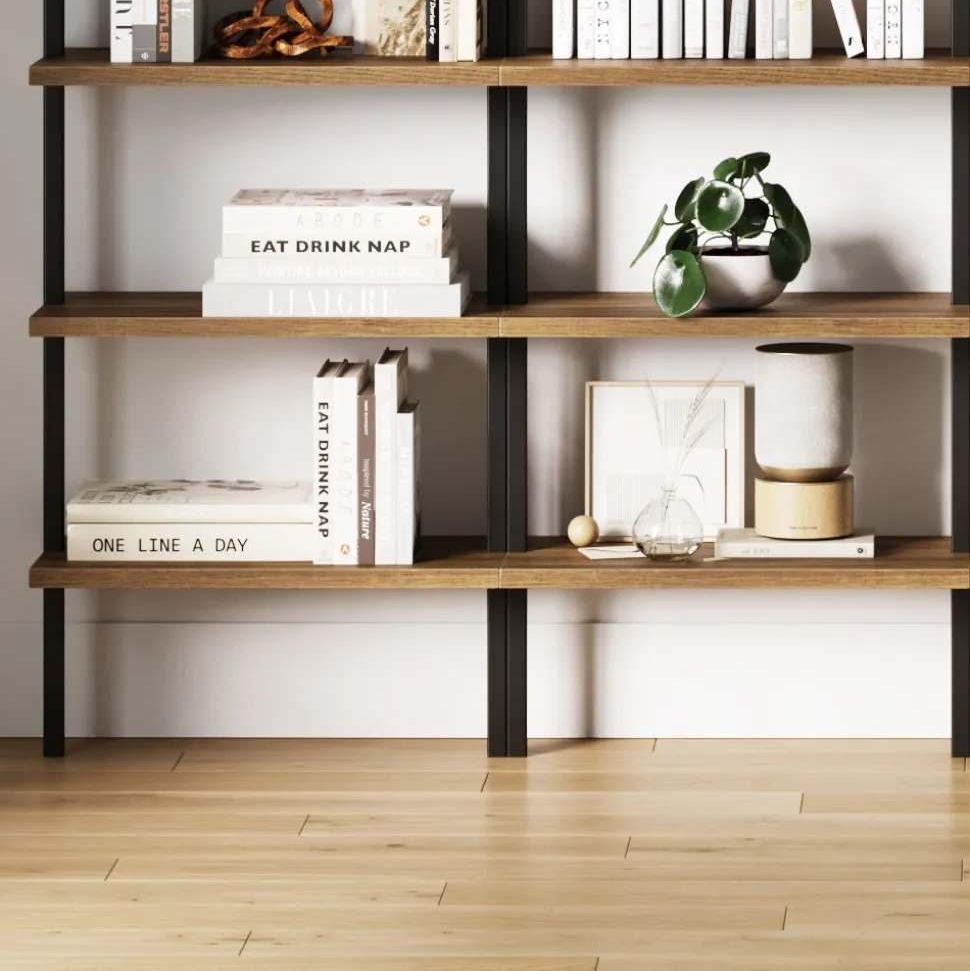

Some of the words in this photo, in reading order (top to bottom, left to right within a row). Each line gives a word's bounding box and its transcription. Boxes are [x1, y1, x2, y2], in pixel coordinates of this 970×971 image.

[428, 26, 436, 45] Gray
[251, 240, 289, 253] EAT
[295, 240, 361, 253] DRINK
[367, 240, 411, 253] NAP
[318, 402, 329, 435] EAT
[318, 439, 329, 496] DRINK
[361, 458, 370, 489] Inspired
[361, 489, 370, 499] by
[318, 501, 329, 538] NAP
[360, 500, 371, 541] Nature
[92, 538, 125, 552] ONE
[138, 538, 181, 552] LINE
[193, 538, 204, 552] A
[215, 538, 249, 552] DAY
